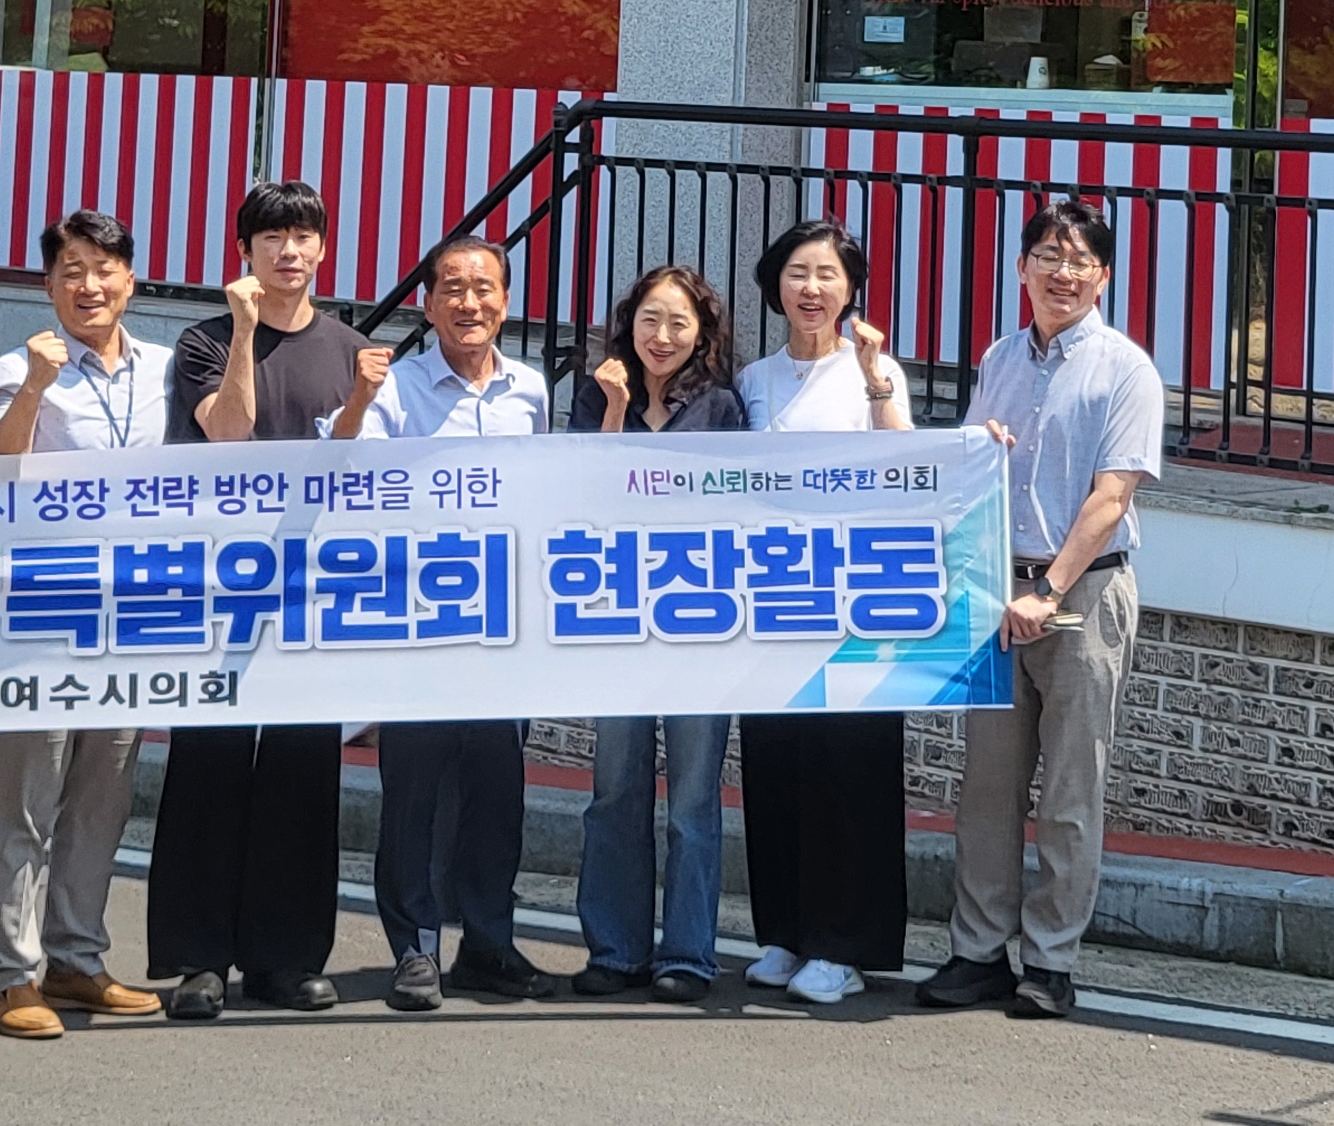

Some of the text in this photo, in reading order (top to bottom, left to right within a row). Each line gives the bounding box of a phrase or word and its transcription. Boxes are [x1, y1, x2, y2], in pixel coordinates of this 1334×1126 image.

[32, 477, 109, 522] 성장
[124, 474, 199, 517] 전략
[214, 471, 289, 515] 방안
[303, 468, 411, 514] 마련을
[429, 466, 502, 510] 위한
[627, 464, 937, 496] 시민이 신뢰하는 따뜻한 의회
[5, 529, 510, 650] 특별위원회
[547, 525, 941, 638] 현장활동
[0, 670, 238, 711] 여수시의회
